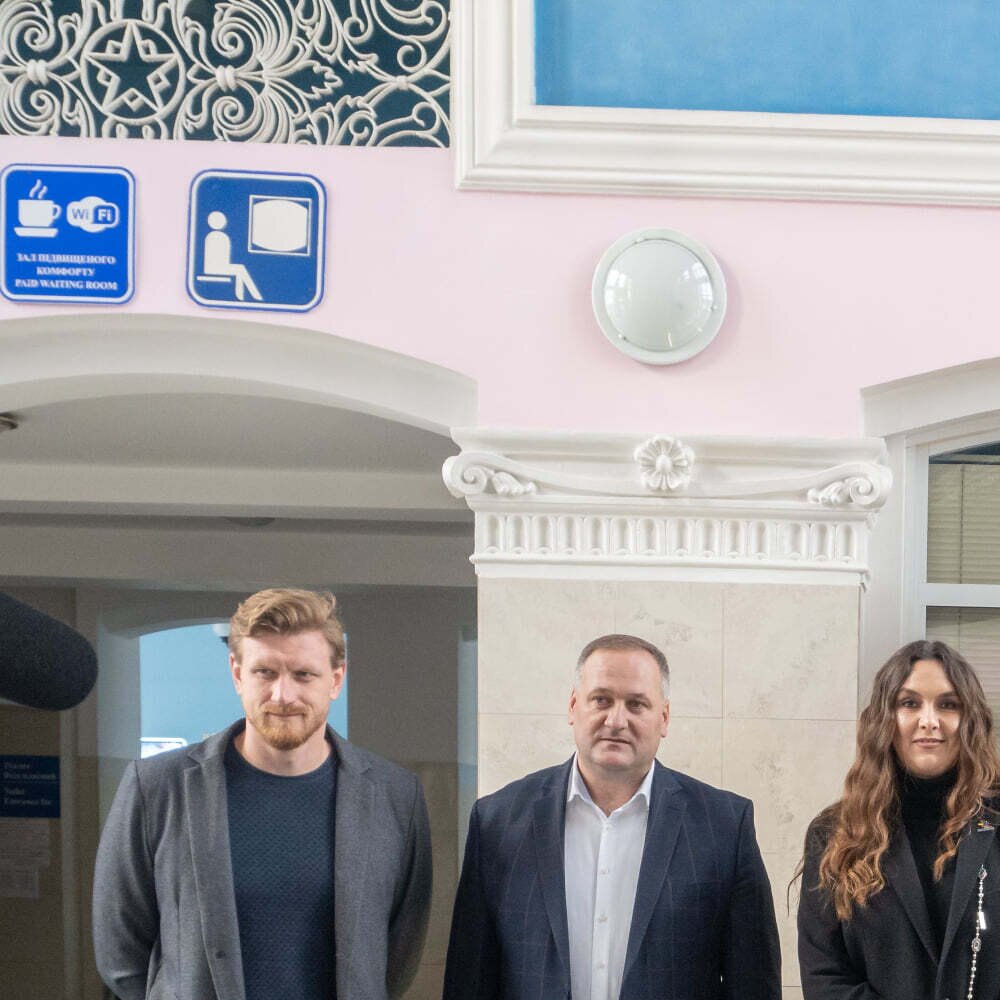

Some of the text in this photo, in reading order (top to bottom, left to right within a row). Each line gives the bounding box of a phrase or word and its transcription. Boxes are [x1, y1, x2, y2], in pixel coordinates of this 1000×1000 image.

[36, 266, 95, 276] КОМФОРТУ
[15, 278, 118, 291] PAID WAITING ROOM
